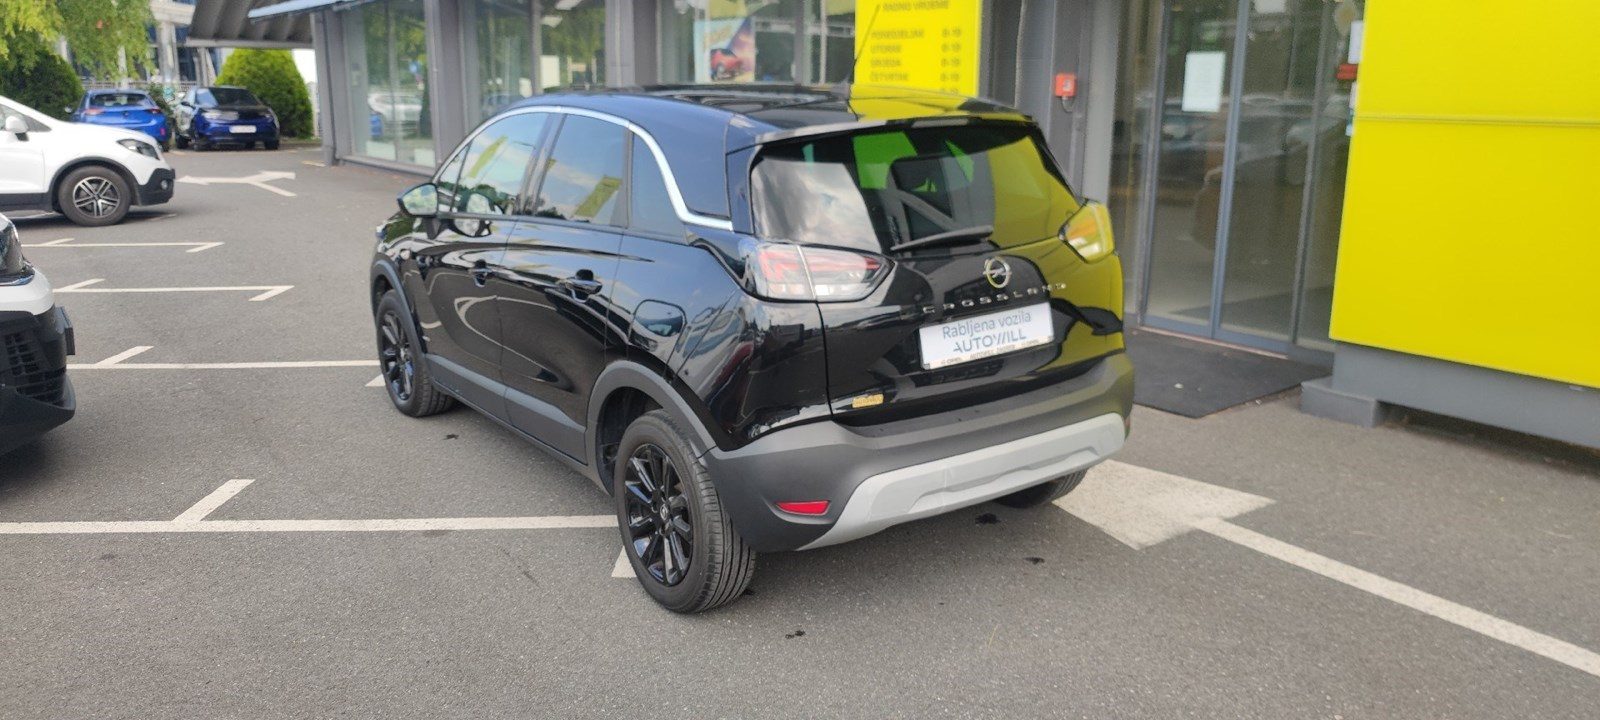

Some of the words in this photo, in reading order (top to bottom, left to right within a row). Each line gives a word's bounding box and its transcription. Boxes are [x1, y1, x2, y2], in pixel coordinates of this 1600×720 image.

[922, 283, 1066, 314] CROSSLAND
[942, 319, 995, 339] Rabljena
[999, 311, 1032, 327] vozila
